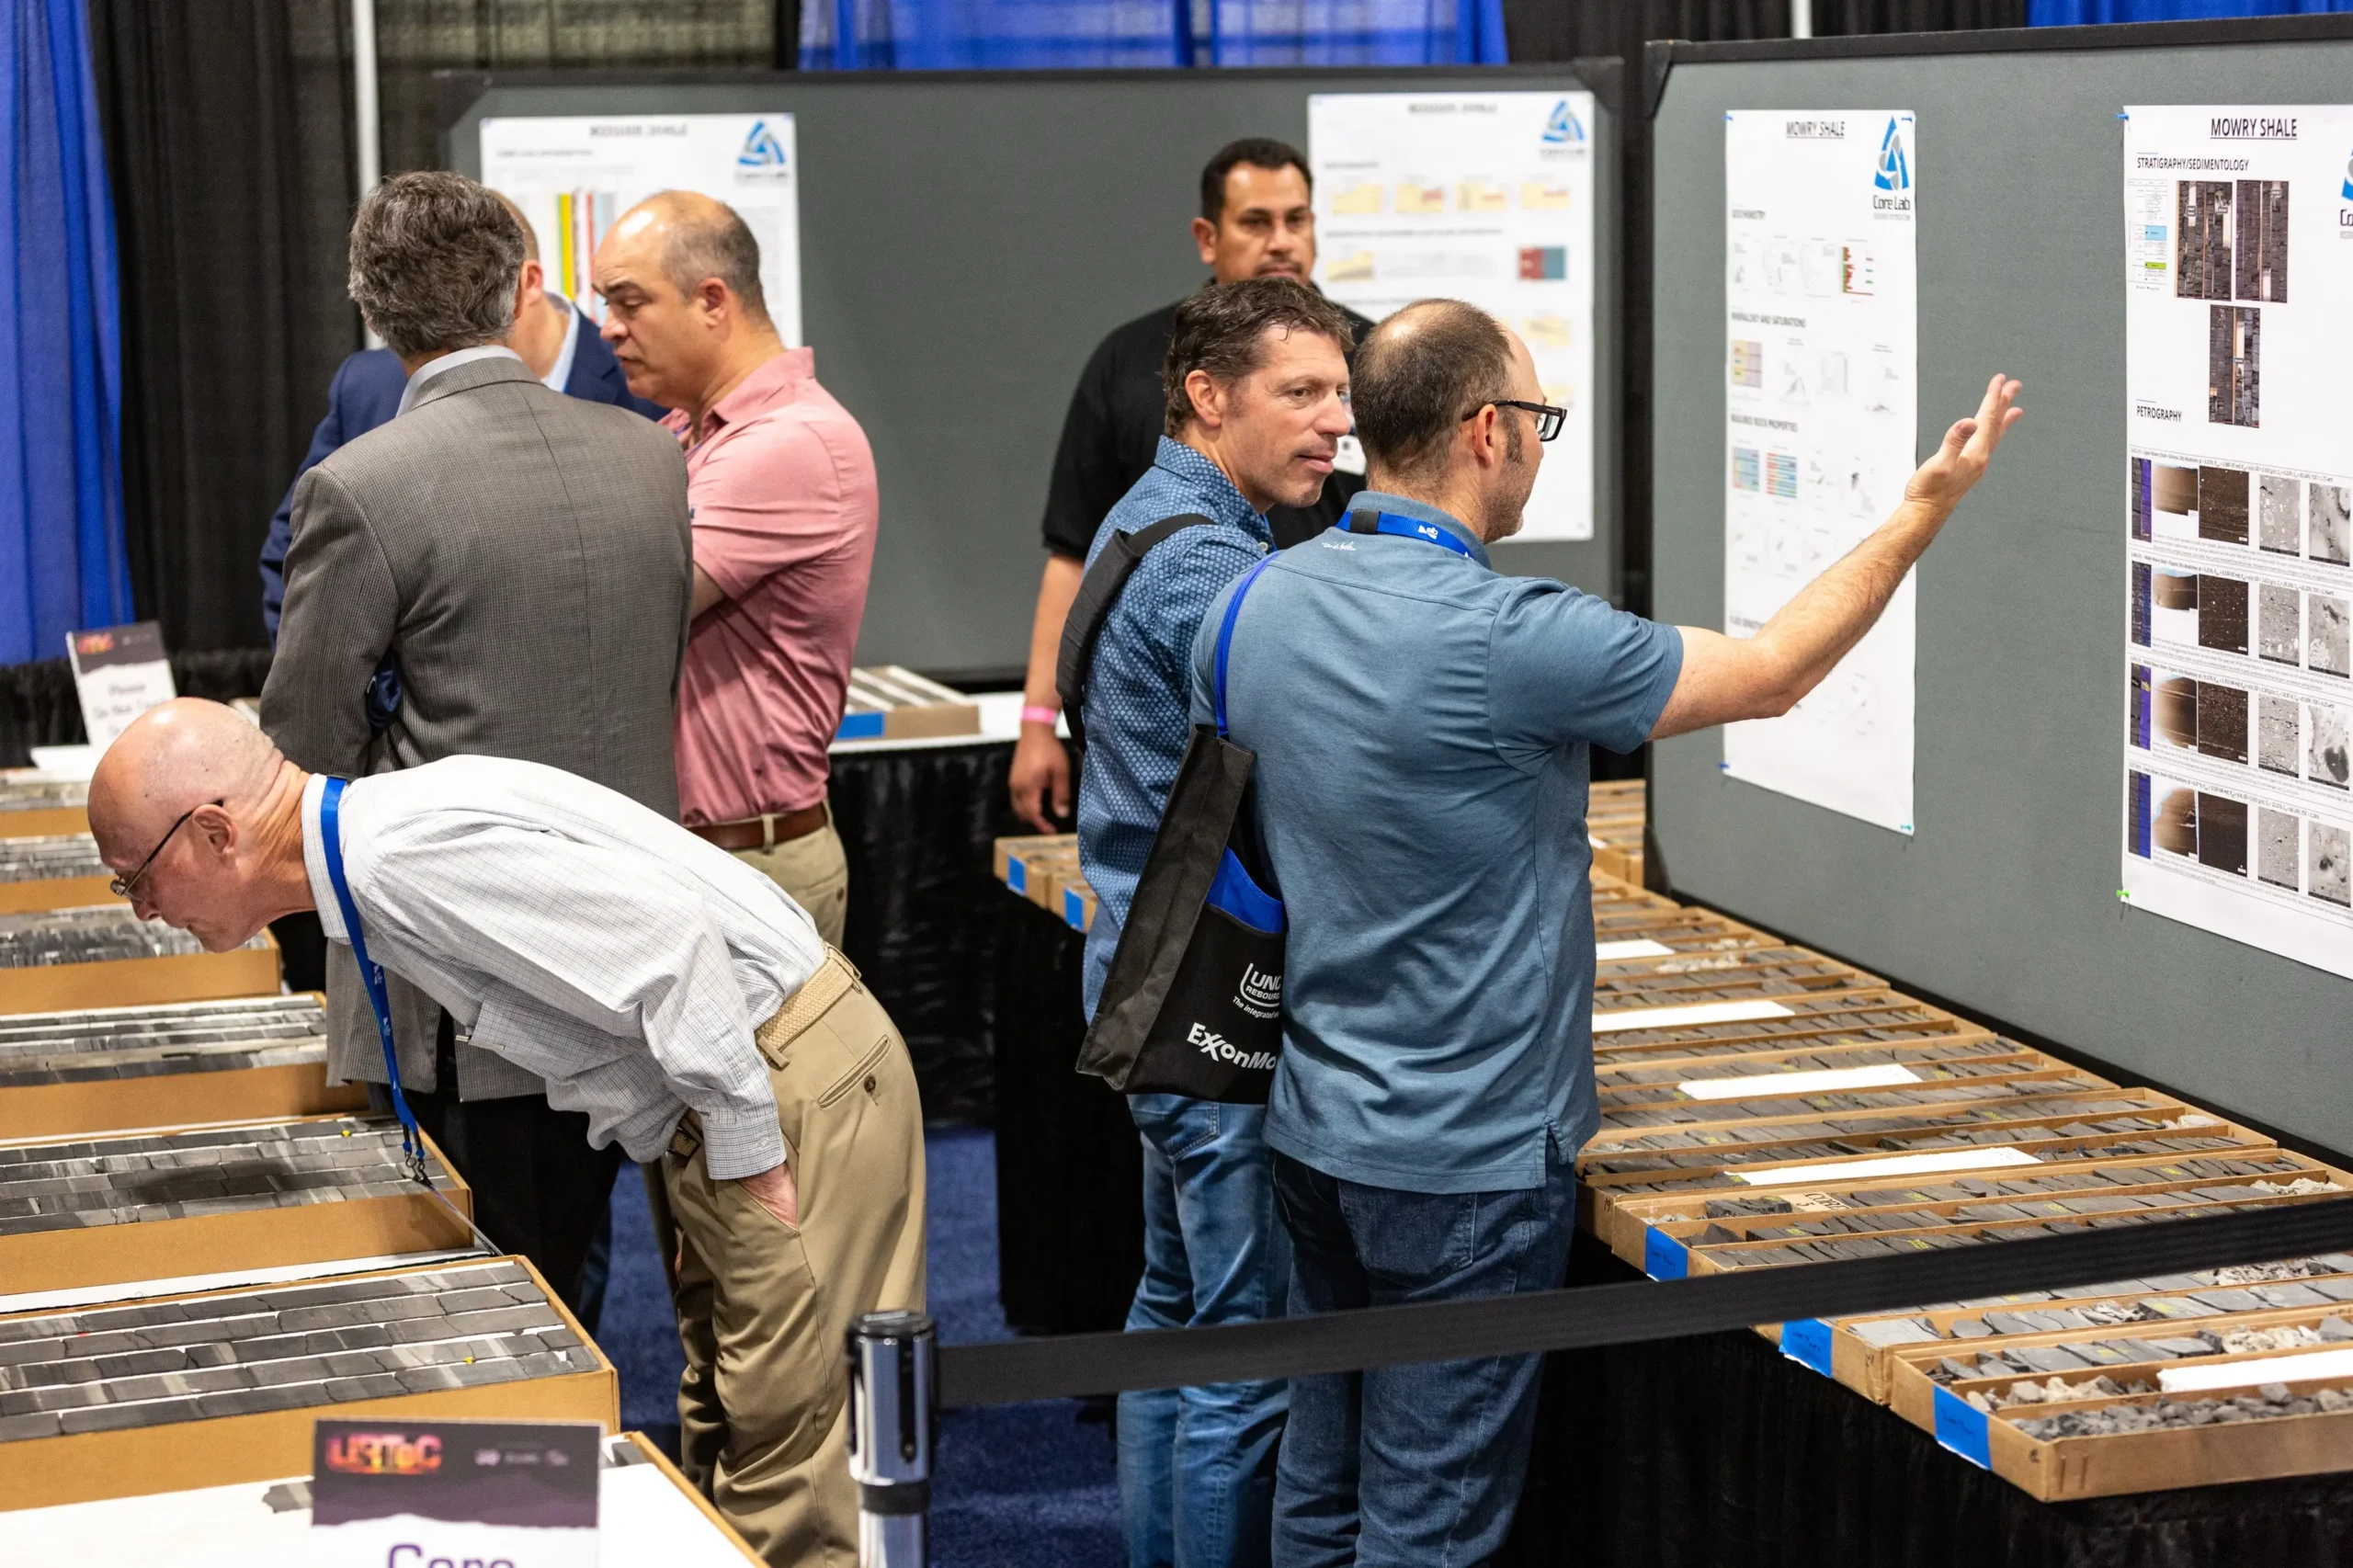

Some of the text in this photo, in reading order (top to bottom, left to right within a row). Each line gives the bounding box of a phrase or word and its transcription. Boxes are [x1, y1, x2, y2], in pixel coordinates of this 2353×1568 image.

[1786, 120, 1845, 137] MOWRY SHALE
[2211, 118, 2298, 137] MOWRY SHALE
[2137, 157, 2249, 171] STRATIGRAPHY/SEDIMENTOLOGY
[1873, 194, 1911, 210] Core Lab
[2136, 405, 2182, 423] PETROGRAPHY
[1233, 995, 1245, 1009] The
